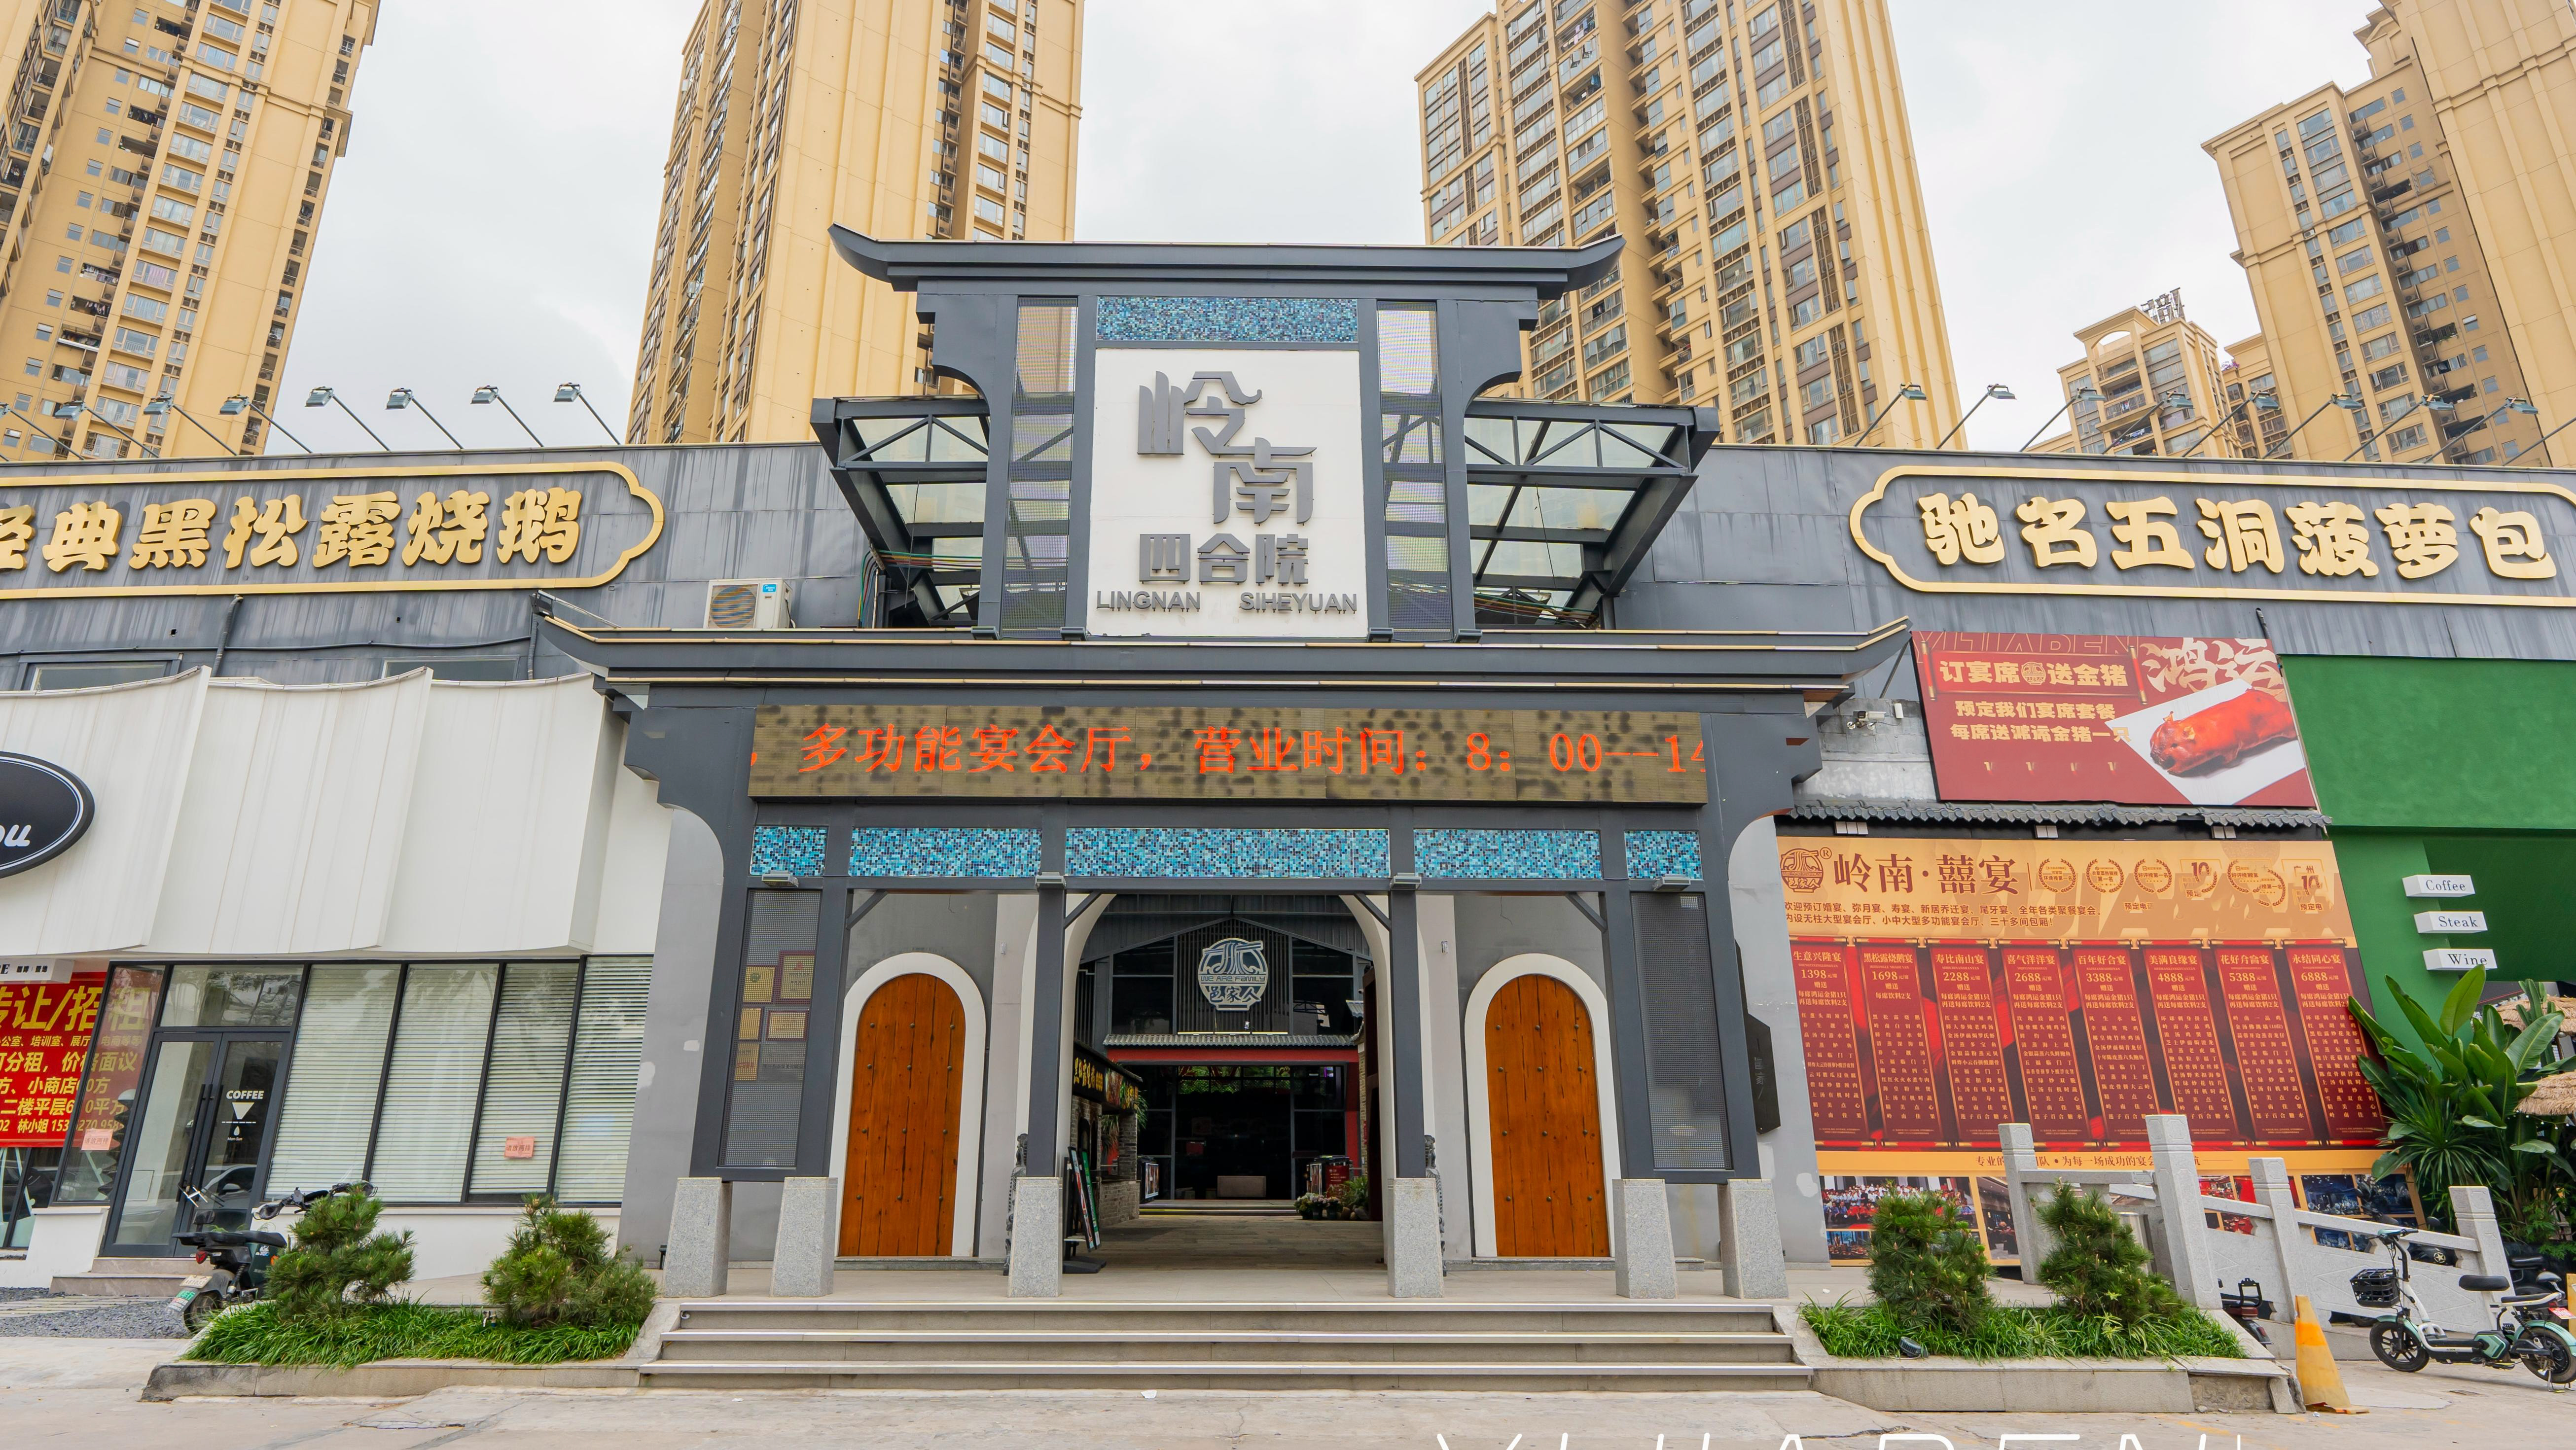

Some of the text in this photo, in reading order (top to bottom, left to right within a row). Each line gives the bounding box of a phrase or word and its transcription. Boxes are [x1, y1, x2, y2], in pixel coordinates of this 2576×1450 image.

[1137, 371, 1317, 525] 岭南
[1918, 493, 2559, 580] 驰名五洞菠萝包
[1139, 533, 1309, 584] 四合院
[1096, 591, 1358, 612] LINGNAN SIHEYUAN
[1939, 661, 2129, 687] 订宴席 送金猪
[1955, 700, 2115, 720] 预定我们宴席套餐
[2426, 880, 2466, 891] Coffee
[2438, 916, 2478, 927] Steak
[1793, 951, 1841, 961] 生意兴隆宴
[1864, 953, 1913, 963] 黑松露烧鹅宴
[1935, 954, 1984, 964] 寿比南山宴
[2007, 954, 2055, 964] 喜气洋洋宴
[2077, 955, 2126, 964] 百年好合宴
[2149, 955, 2198, 964] 美满良缘宴
[2292, 954, 2342, 964] 永结同心宴
[2447, 954, 2488, 965] Wine
[1801, 969, 1826, 979] 1398
[1872, 971, 1898, 980] 1698
[1943, 972, 1969, 981] 2288
[2015, 972, 2041, 982] 2688
[2086, 973, 2112, 982] 3388
[2157, 973, 2183, 982] 4888
[2229, 972, 2256, 982] 5388
[2301, 972, 2328, 981] 6888
[226, 1090, 264, 1099] COFFEE
[17, 1118, 48, 1133] 林小姐
